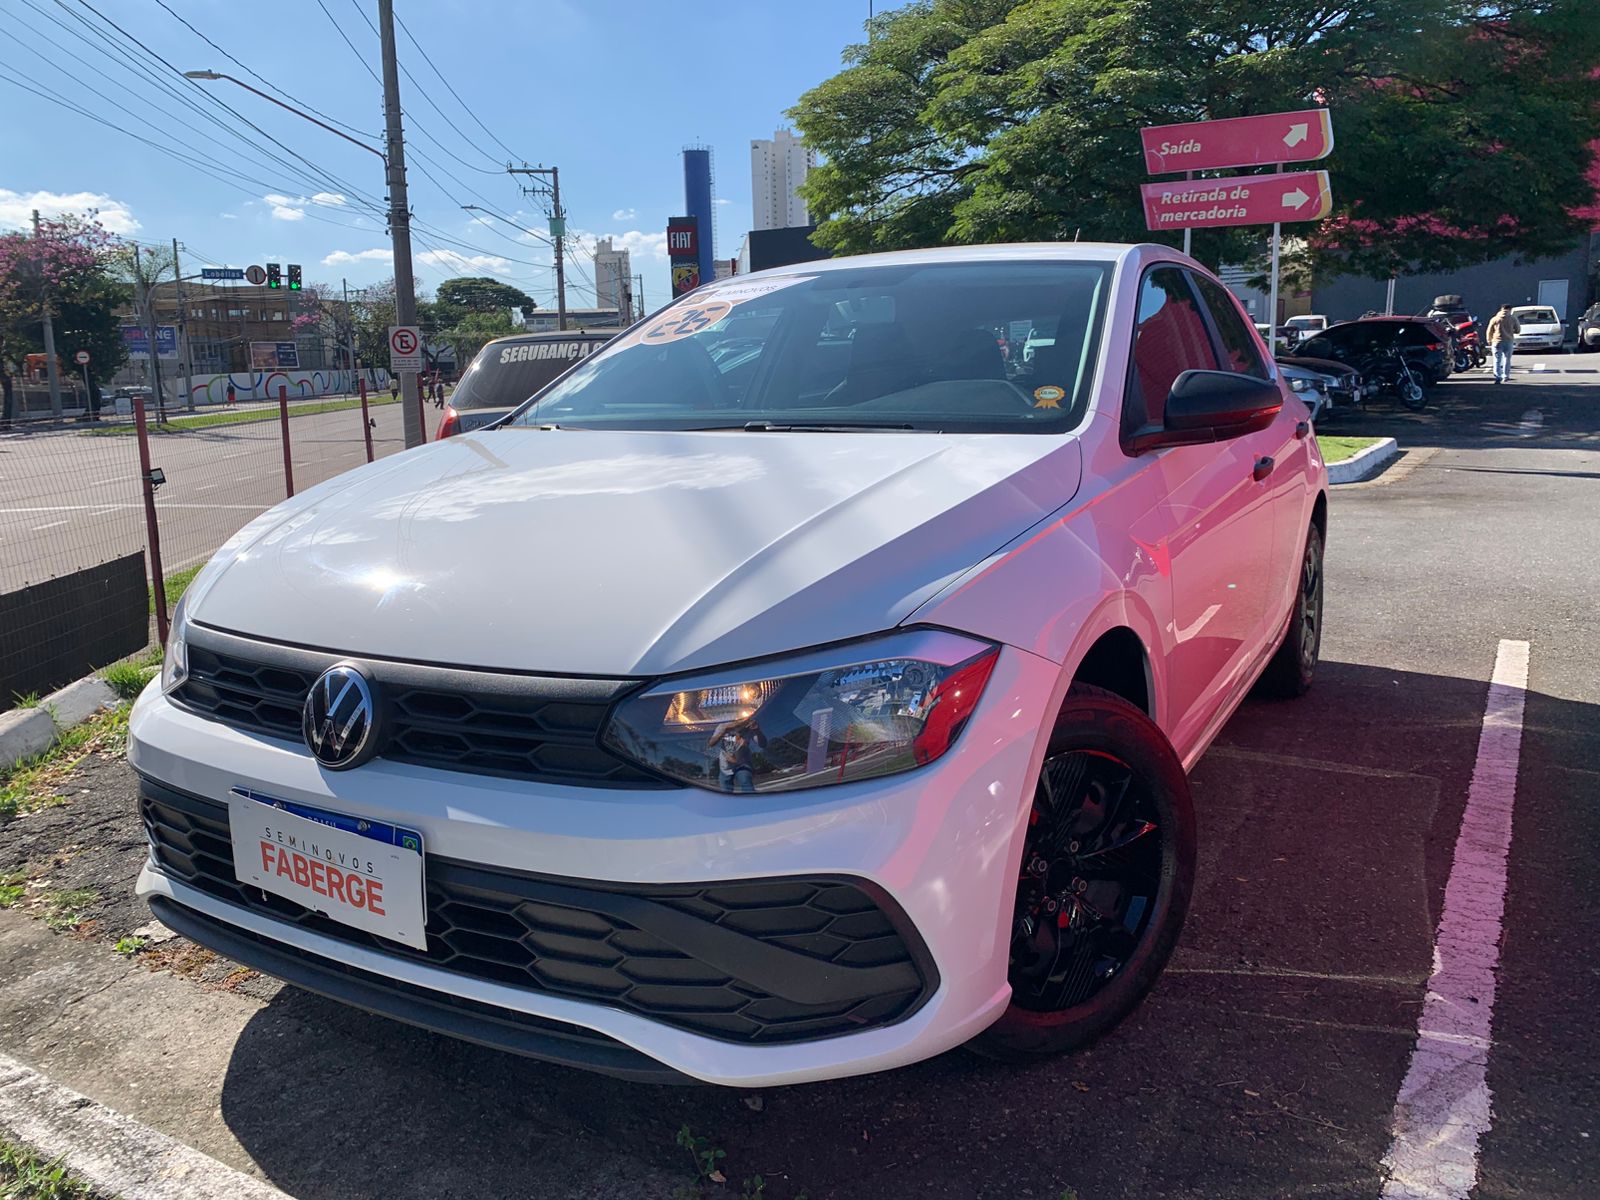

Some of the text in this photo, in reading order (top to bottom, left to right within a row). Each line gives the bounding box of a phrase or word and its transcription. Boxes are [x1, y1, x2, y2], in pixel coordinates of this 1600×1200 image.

[1160, 139, 1201, 156] Saída
[1161, 186, 1249, 205] Retirada de
[1160, 204, 1247, 222] mercadoria
[670, 231, 692, 249] FIAT
[500, 342, 589, 364] SEGURANÇA
[265, 827, 374, 873] SEMINOVOS
[260, 841, 386, 916] FABERGE
